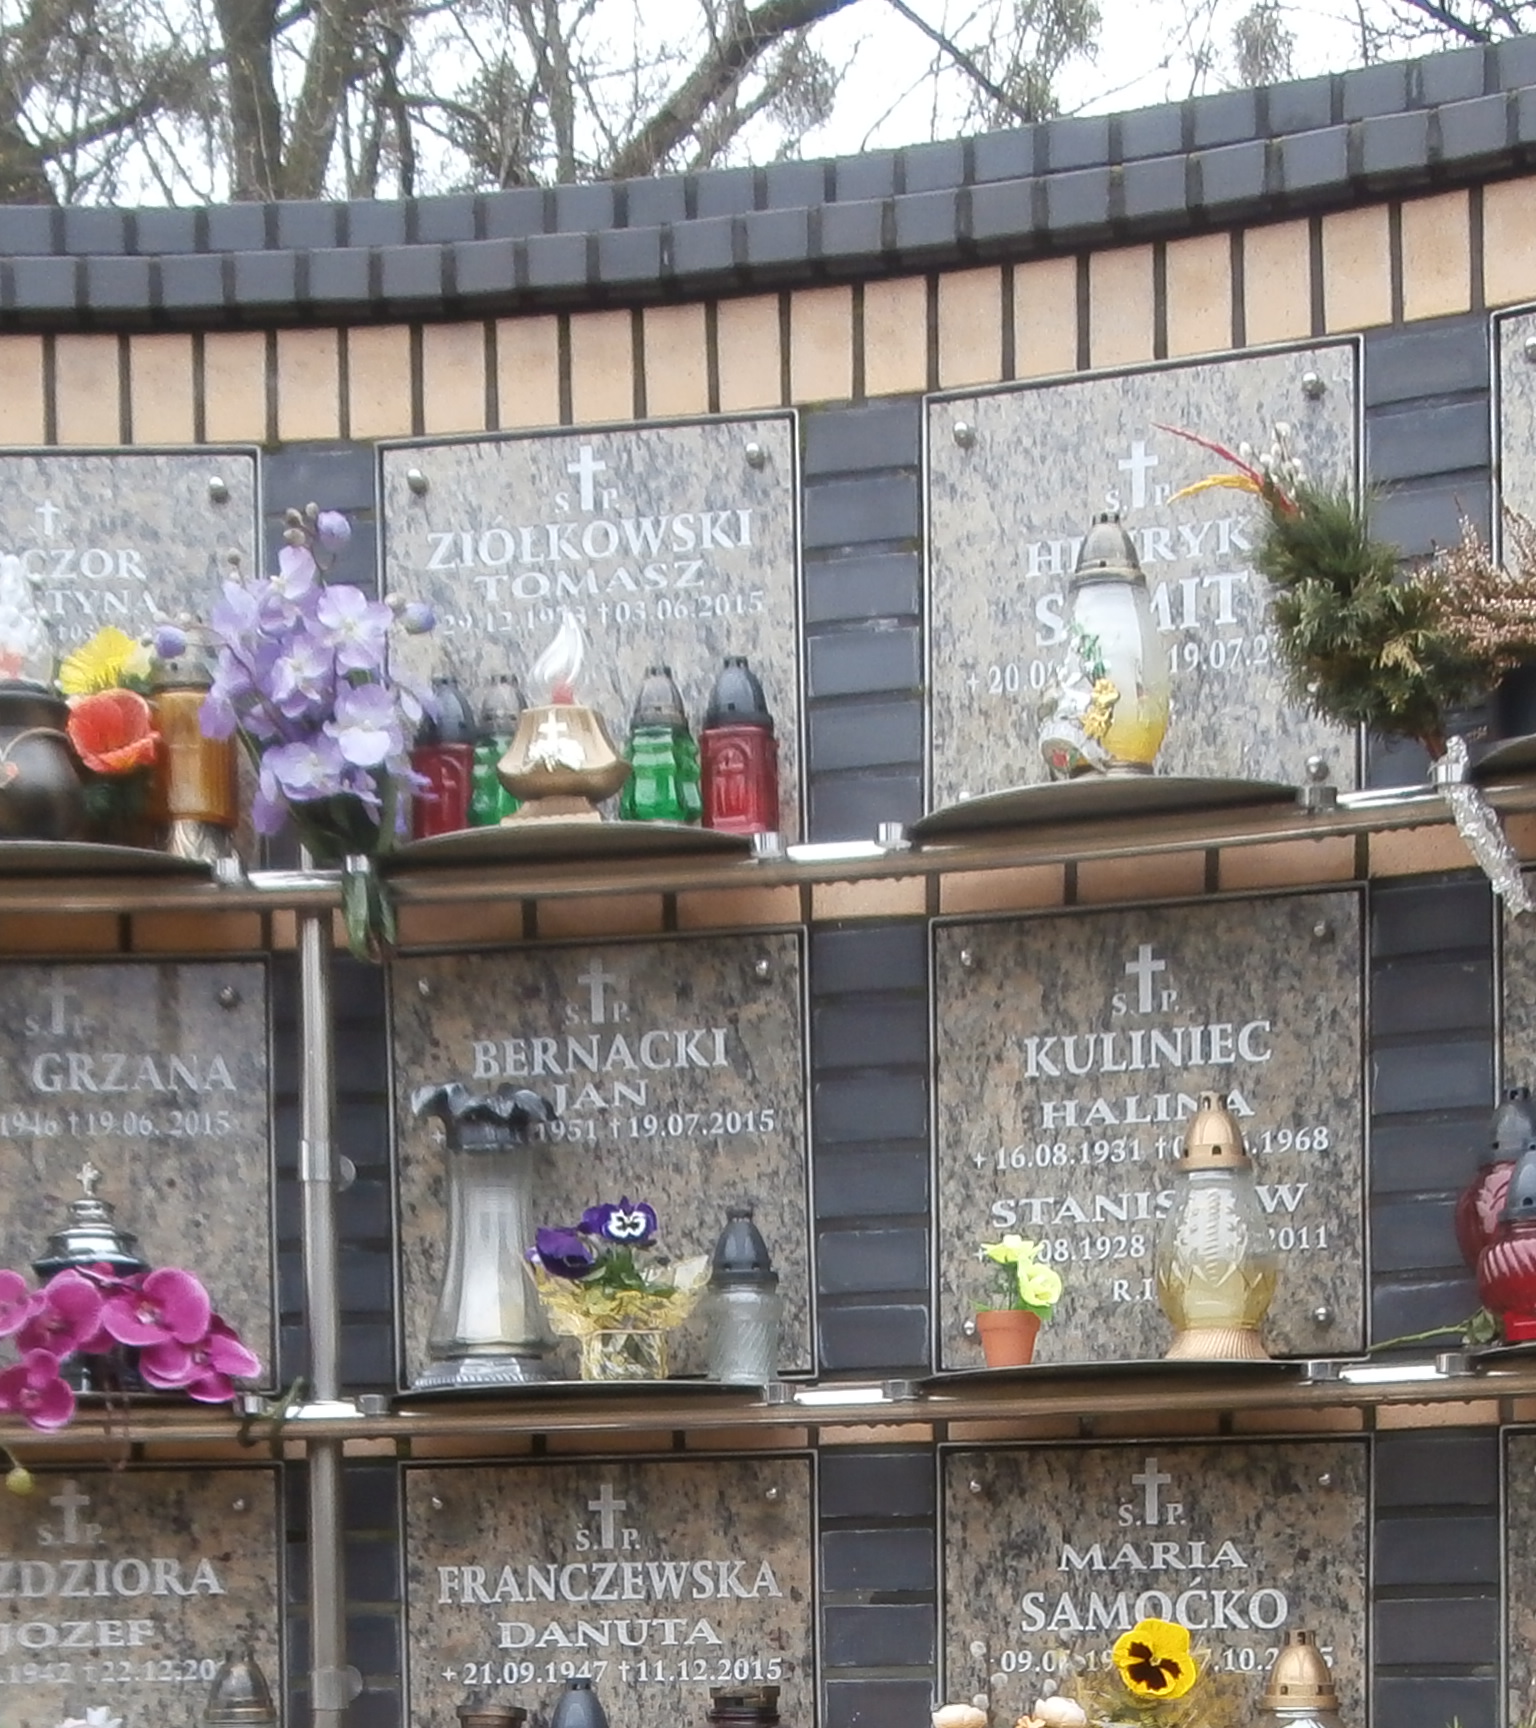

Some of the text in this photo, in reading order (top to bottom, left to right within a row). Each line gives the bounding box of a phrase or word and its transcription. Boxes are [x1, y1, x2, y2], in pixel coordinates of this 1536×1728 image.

[474, 560, 705, 601] TOMASZ
[472, 1027, 729, 1079] BERNACKI
[1023, 1020, 1272, 1078] KULINIEC
[31, 1052, 238, 1093] GRZANA
[552, 1079, 649, 1116] JAN
[629, 1109, 775, 1139] 19.07.2015
[996, 1139, 1142, 1170] 16.08.1931
[1057, 1540, 1248, 1571] MARIA
[437, 1559, 783, 1605] FRANCZEWSKA
[1021, 1577, 1288, 1633] SAMOĆKO
[498, 1618, 722, 1649] DANUTA
[463, 1656, 783, 1686] 21.09.1947 11.12.2015
